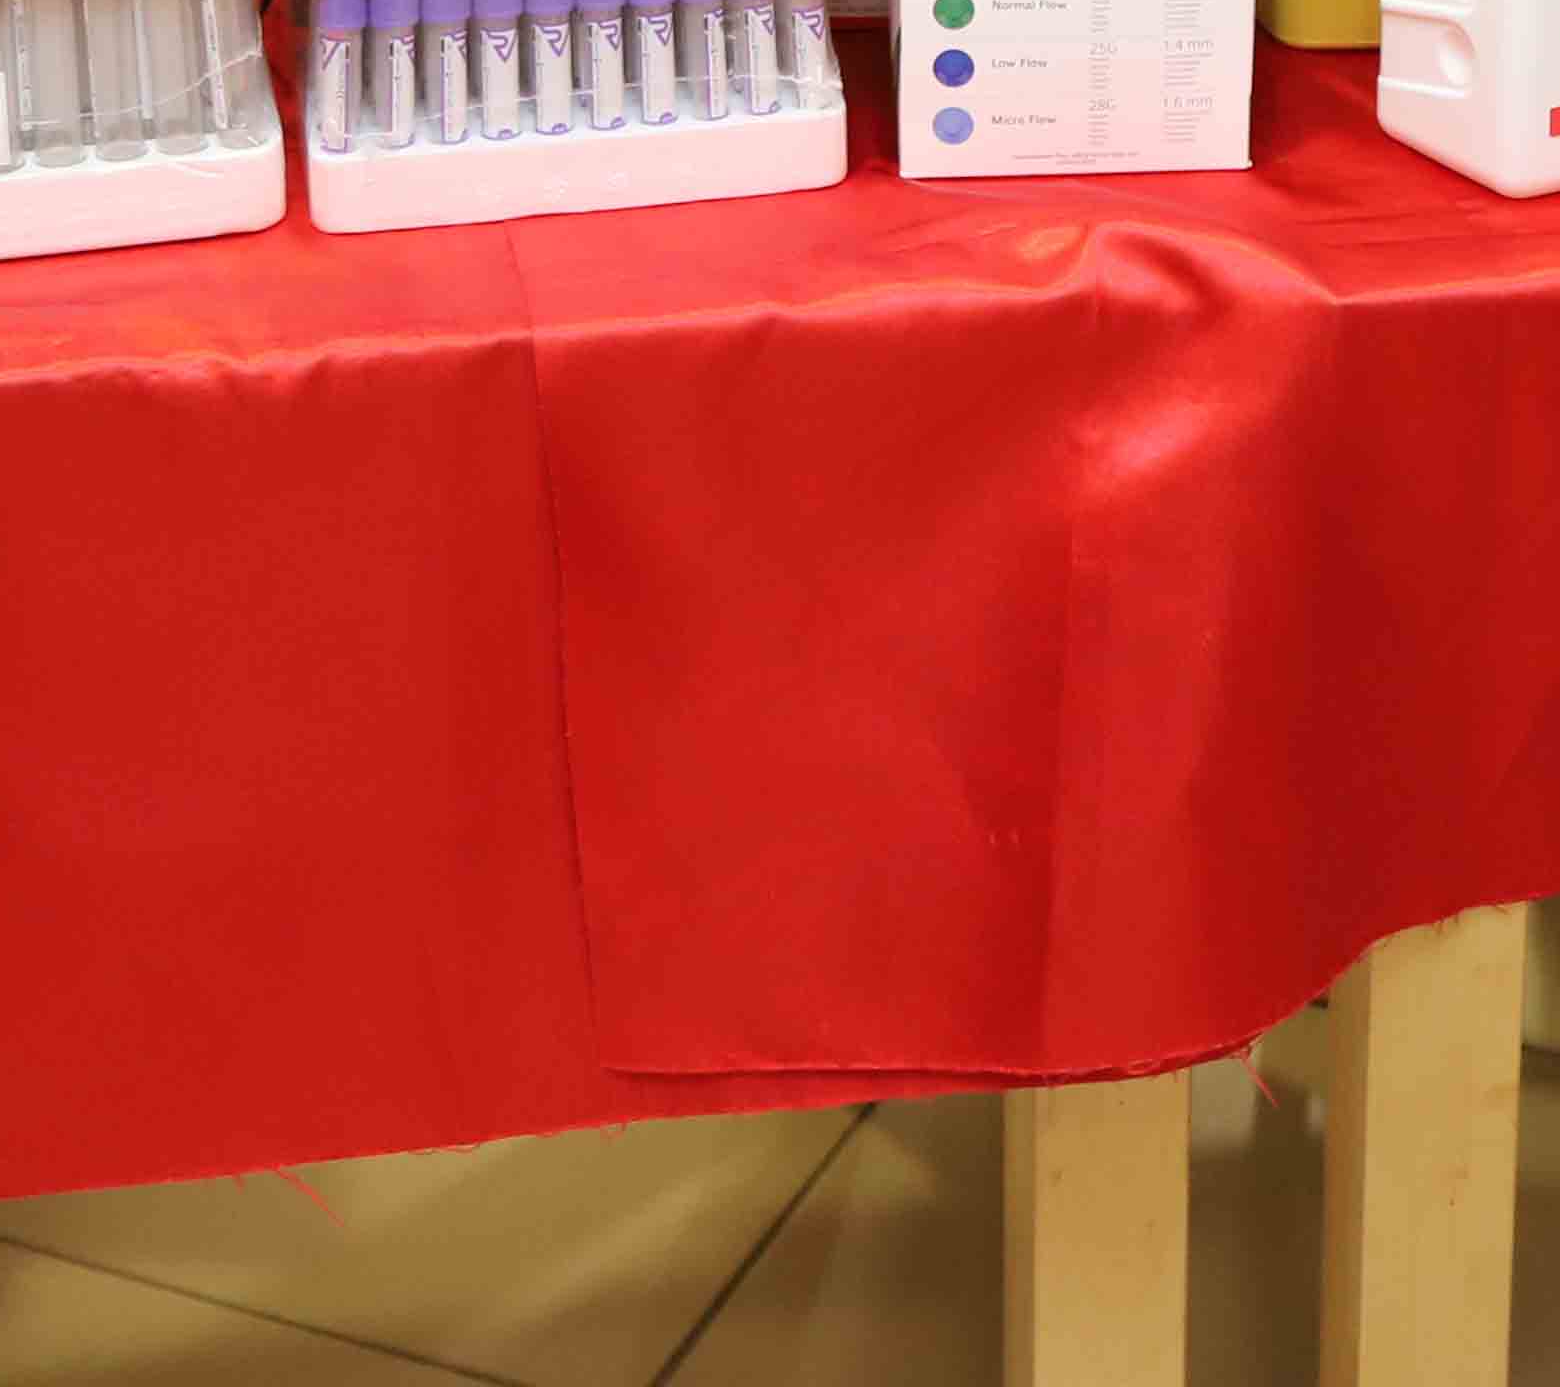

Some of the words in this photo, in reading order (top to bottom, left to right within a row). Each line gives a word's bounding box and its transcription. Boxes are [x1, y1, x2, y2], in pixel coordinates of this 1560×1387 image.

[992, 0, 1035, 11] Normal
[1039, 0, 1067, 10] Flow
[992, 58, 1016, 68] Low
[1020, 58, 1048, 68] Flow
[992, 115, 1024, 125] Micro
[1029, 114, 1056, 125] Flow
